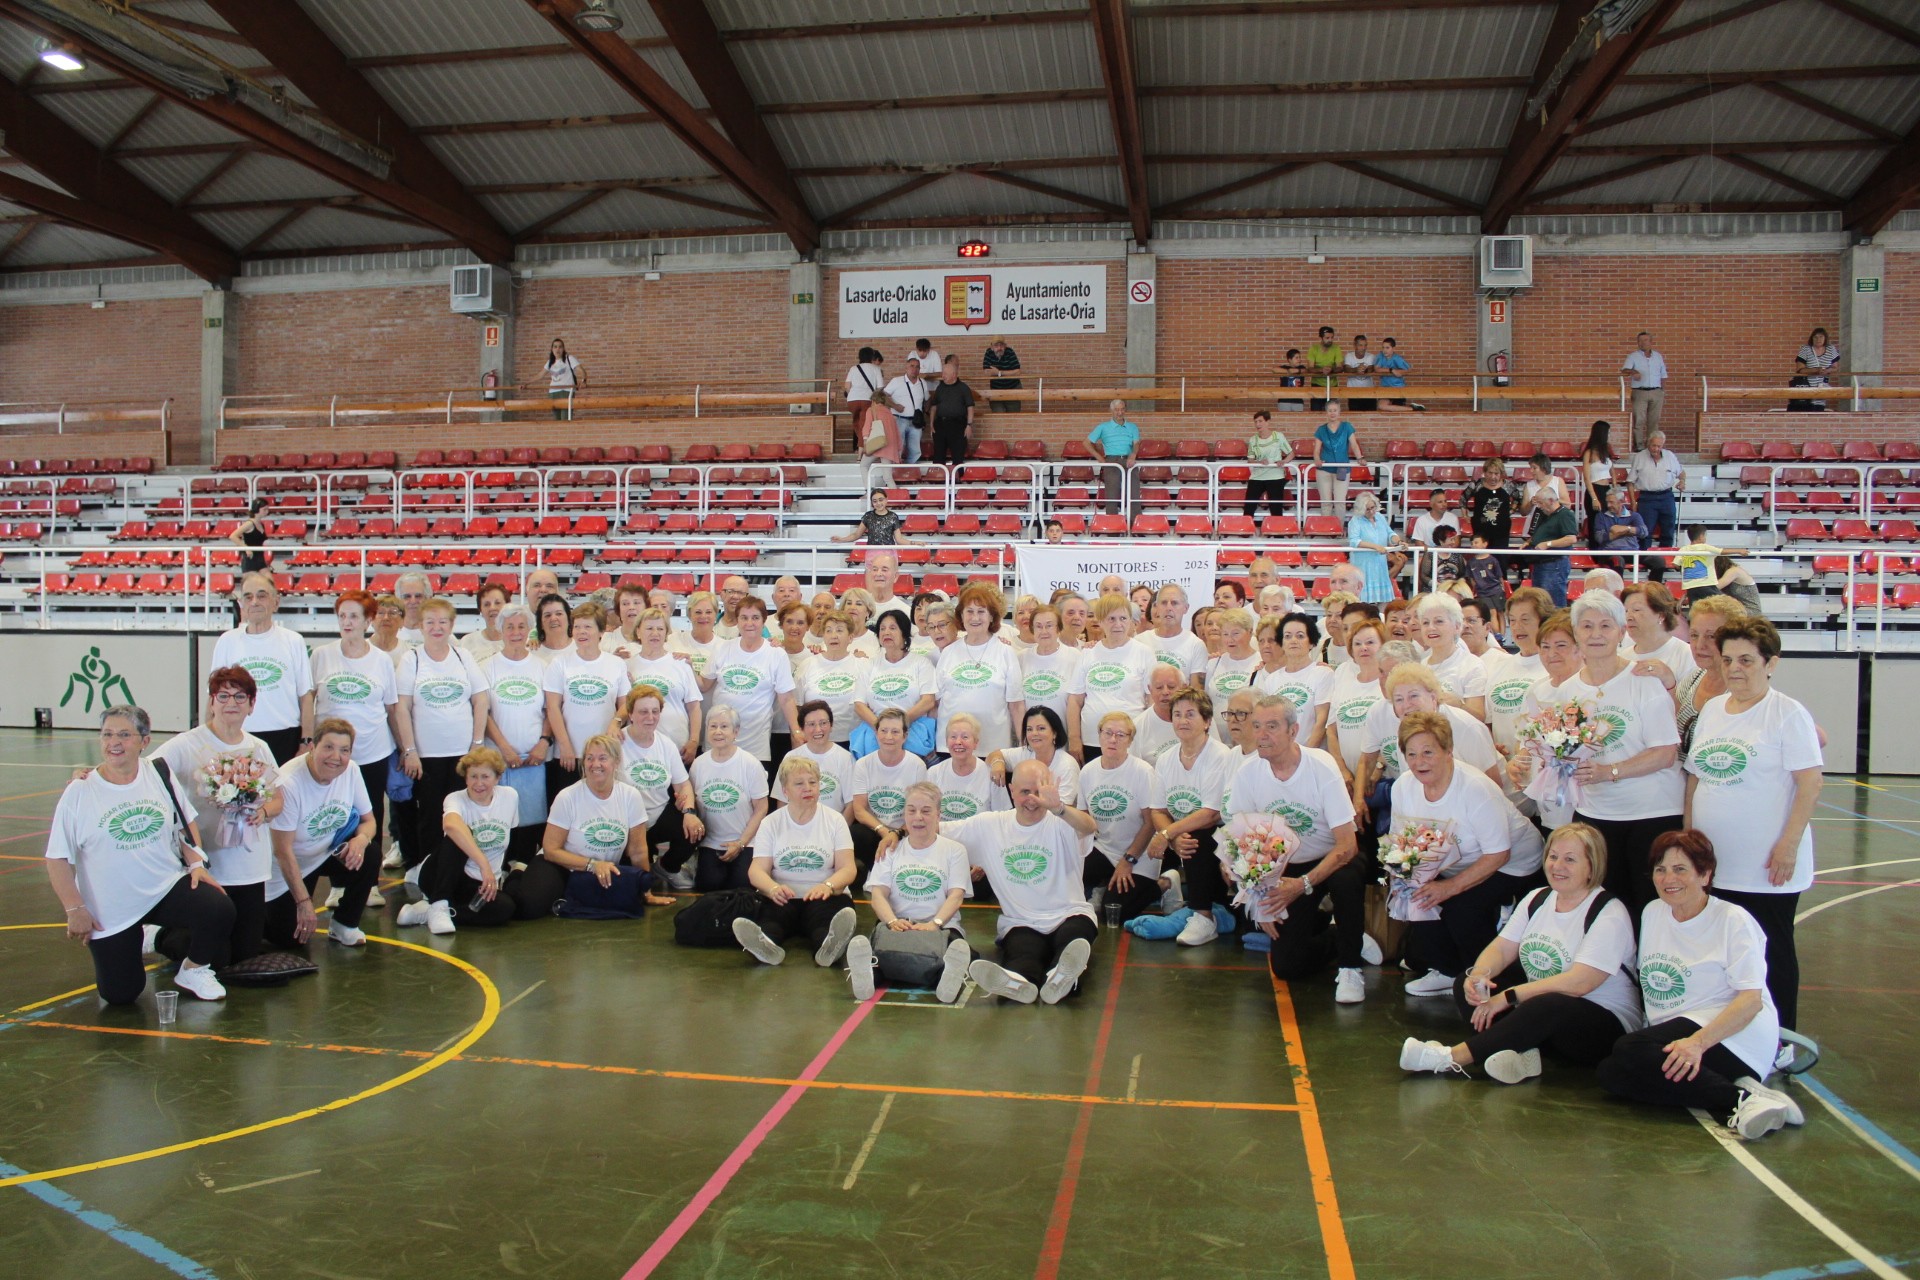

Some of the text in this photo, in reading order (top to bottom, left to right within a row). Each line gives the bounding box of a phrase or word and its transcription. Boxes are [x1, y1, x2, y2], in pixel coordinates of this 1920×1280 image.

[846, 284, 936, 303] Lasarte-Oriako
[1006, 281, 1091, 302] Ayuntamiento
[872, 307, 908, 324] Udala
[1002, 302, 1096, 320] de Lasarte-Oria
[1077, 562, 1158, 574] MONITORES
[1184, 560, 1209, 570] 2025
[1050, 580, 1080, 592] SOIS
[1604, 705, 1634, 722] JUBILADO
[1728, 737, 1757, 757] JUBILADO
[1726, 778, 1744, 786] ORIA
[98, 809, 116, 828] HOGAR
[136, 799, 167, 812] JUBILADO
[1670, 999, 1685, 1009] ORIA
